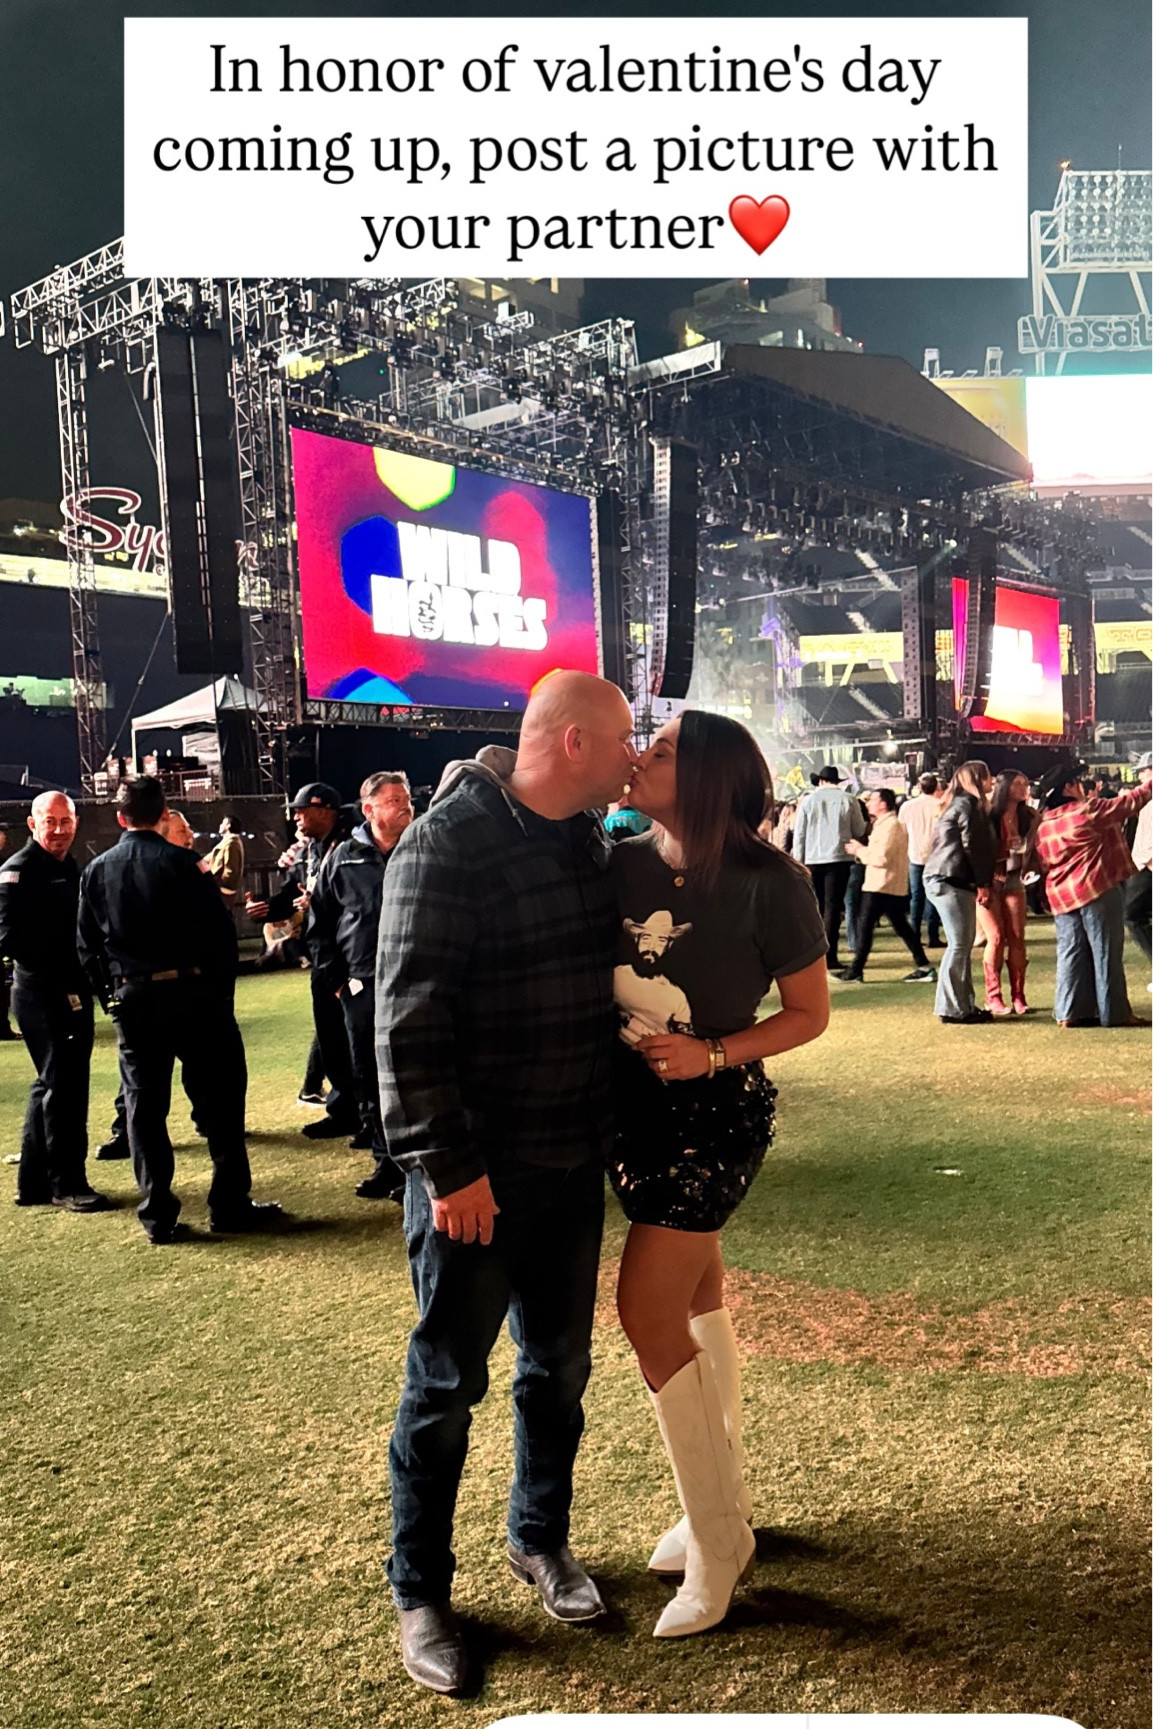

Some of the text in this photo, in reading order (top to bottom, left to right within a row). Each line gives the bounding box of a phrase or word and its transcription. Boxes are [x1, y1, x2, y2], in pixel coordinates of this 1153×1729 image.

[1027, 313, 1152, 348] Viasat
[397, 521, 522, 596] WILD
[370, 574, 549, 650] HORSES
